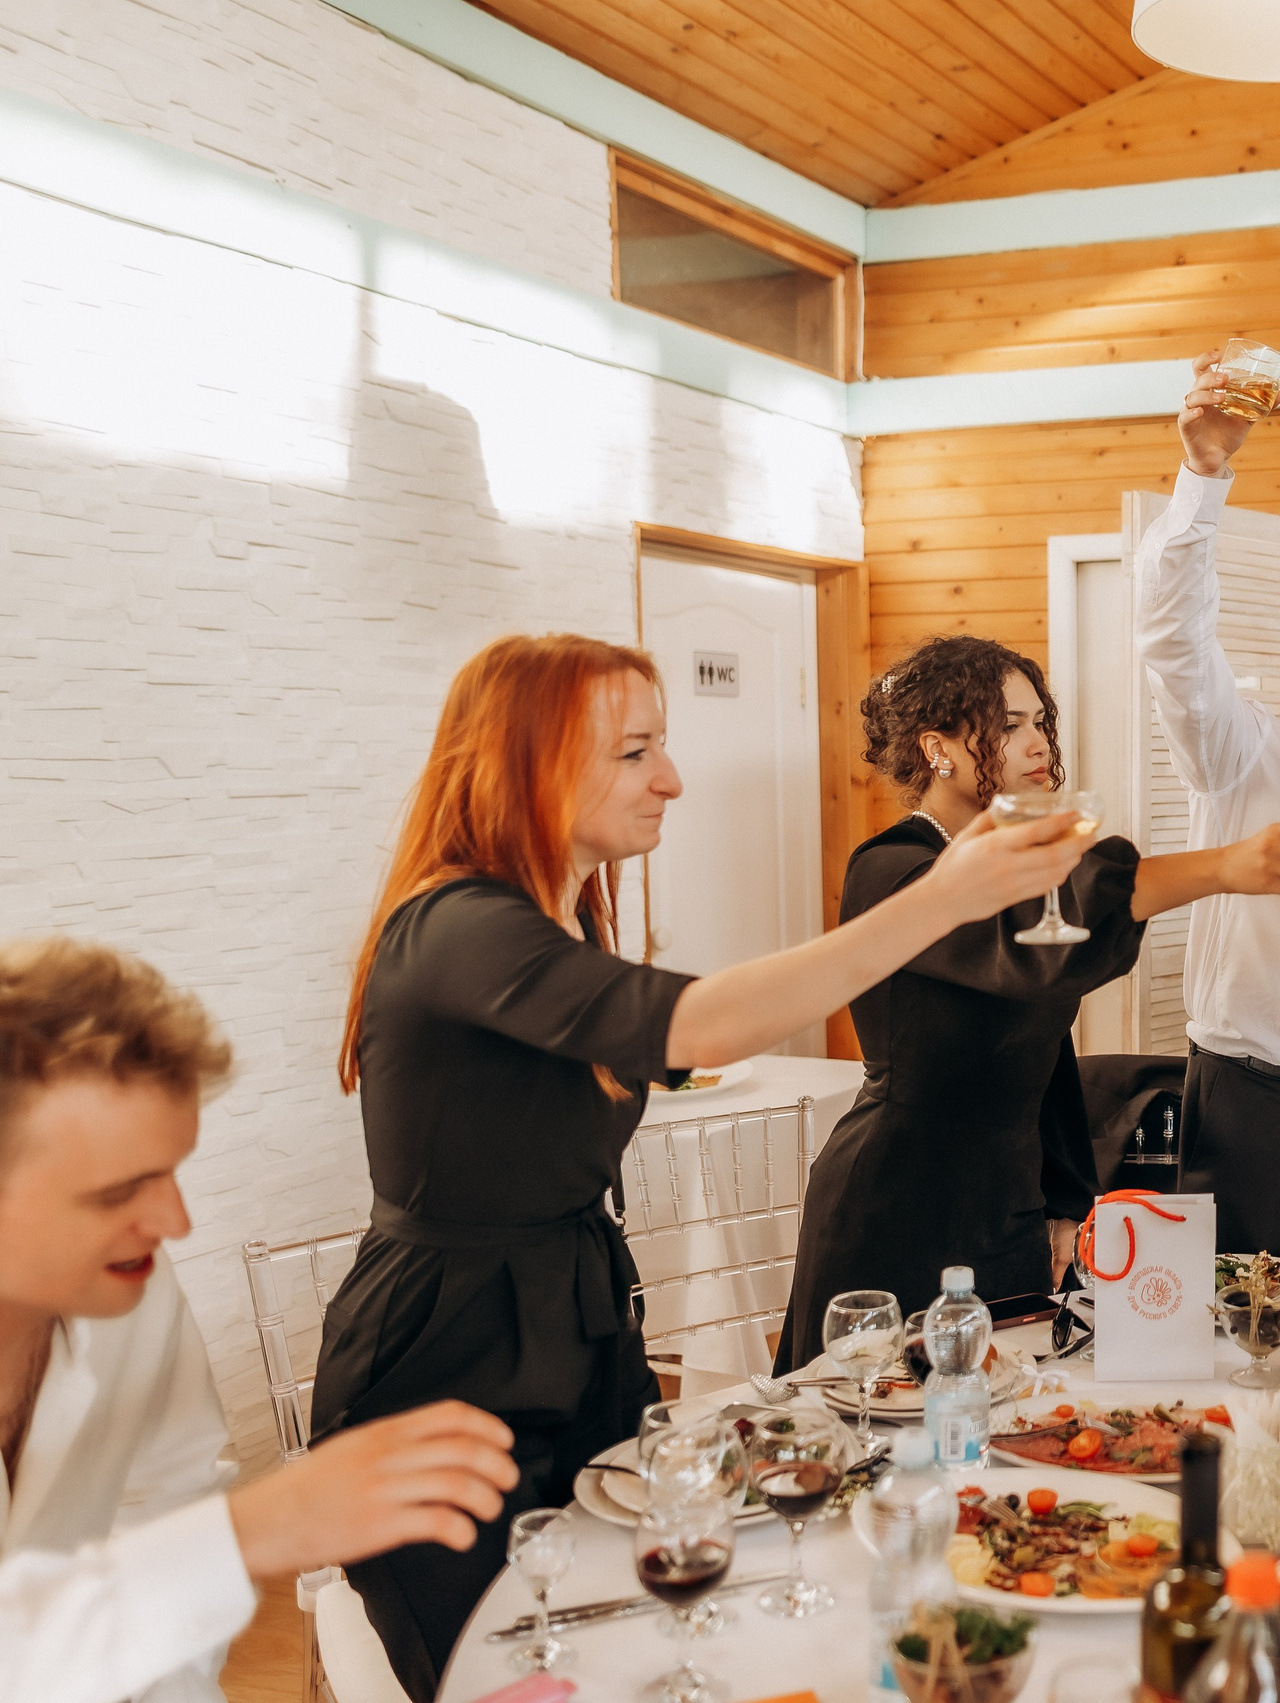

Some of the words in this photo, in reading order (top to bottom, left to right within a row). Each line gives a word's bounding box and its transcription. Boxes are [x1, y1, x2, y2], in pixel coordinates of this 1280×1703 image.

[717, 666, 735, 683] WC
[1128, 1266, 1163, 1290] ВОЛОГОДСКАЯ
[1165, 1267, 1182, 1290] ОБЛАСТЬ
[1127, 1295, 1140, 1312] ДУША
[1138, 1308, 1167, 1320] РУССКОГО
[1167, 1295, 1183, 1315] СЕВЕРА
